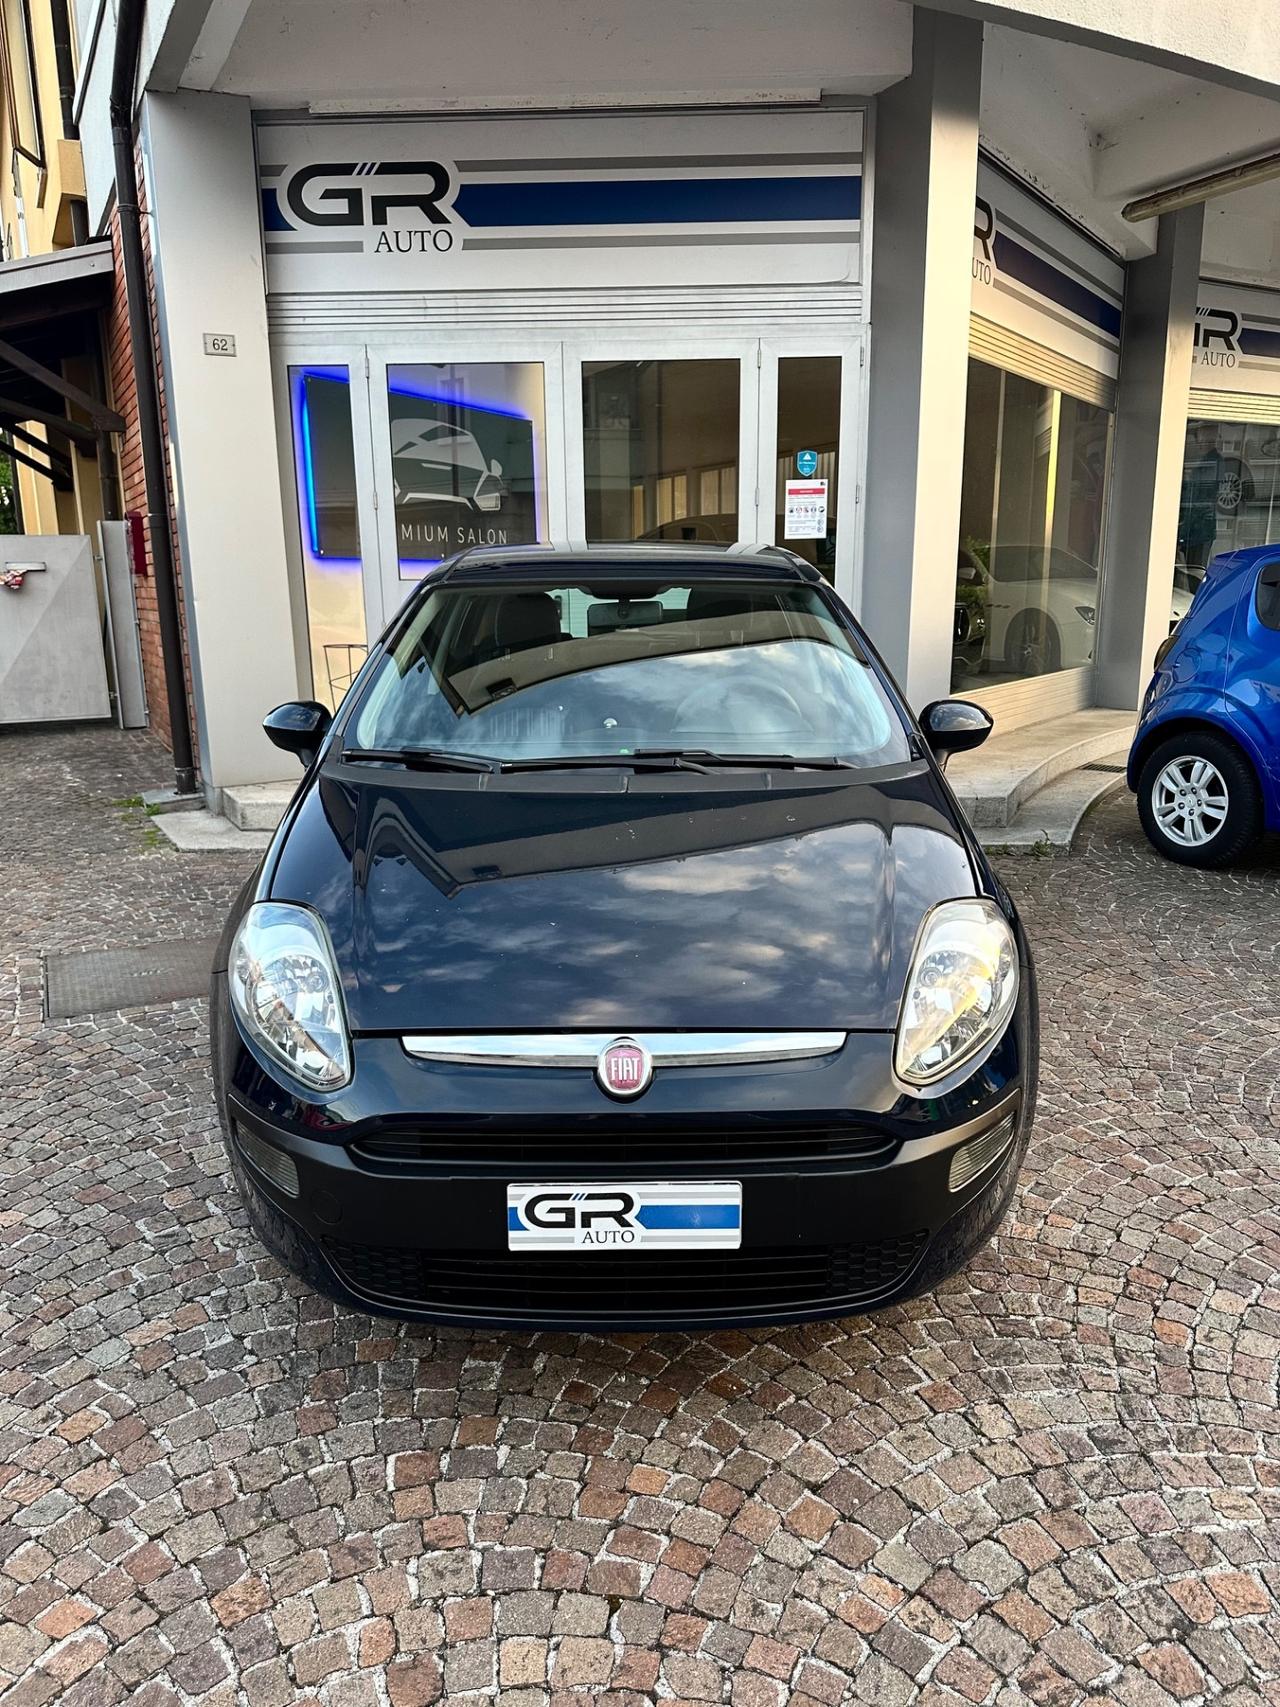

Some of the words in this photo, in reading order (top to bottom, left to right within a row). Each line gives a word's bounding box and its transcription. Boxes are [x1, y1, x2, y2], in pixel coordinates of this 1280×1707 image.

[287, 161, 452, 226] GR
[374, 229, 453, 252] AUTO
[1194, 307, 1238, 351] R
[212, 338, 228, 351] 62
[1201, 351, 1236, 368] AUTO
[457, 527, 507, 544] SALON
[611, 1057, 640, 1081] FIAT
[524, 1192, 635, 1229] GR
[582, 1230, 635, 1244] AUTO
